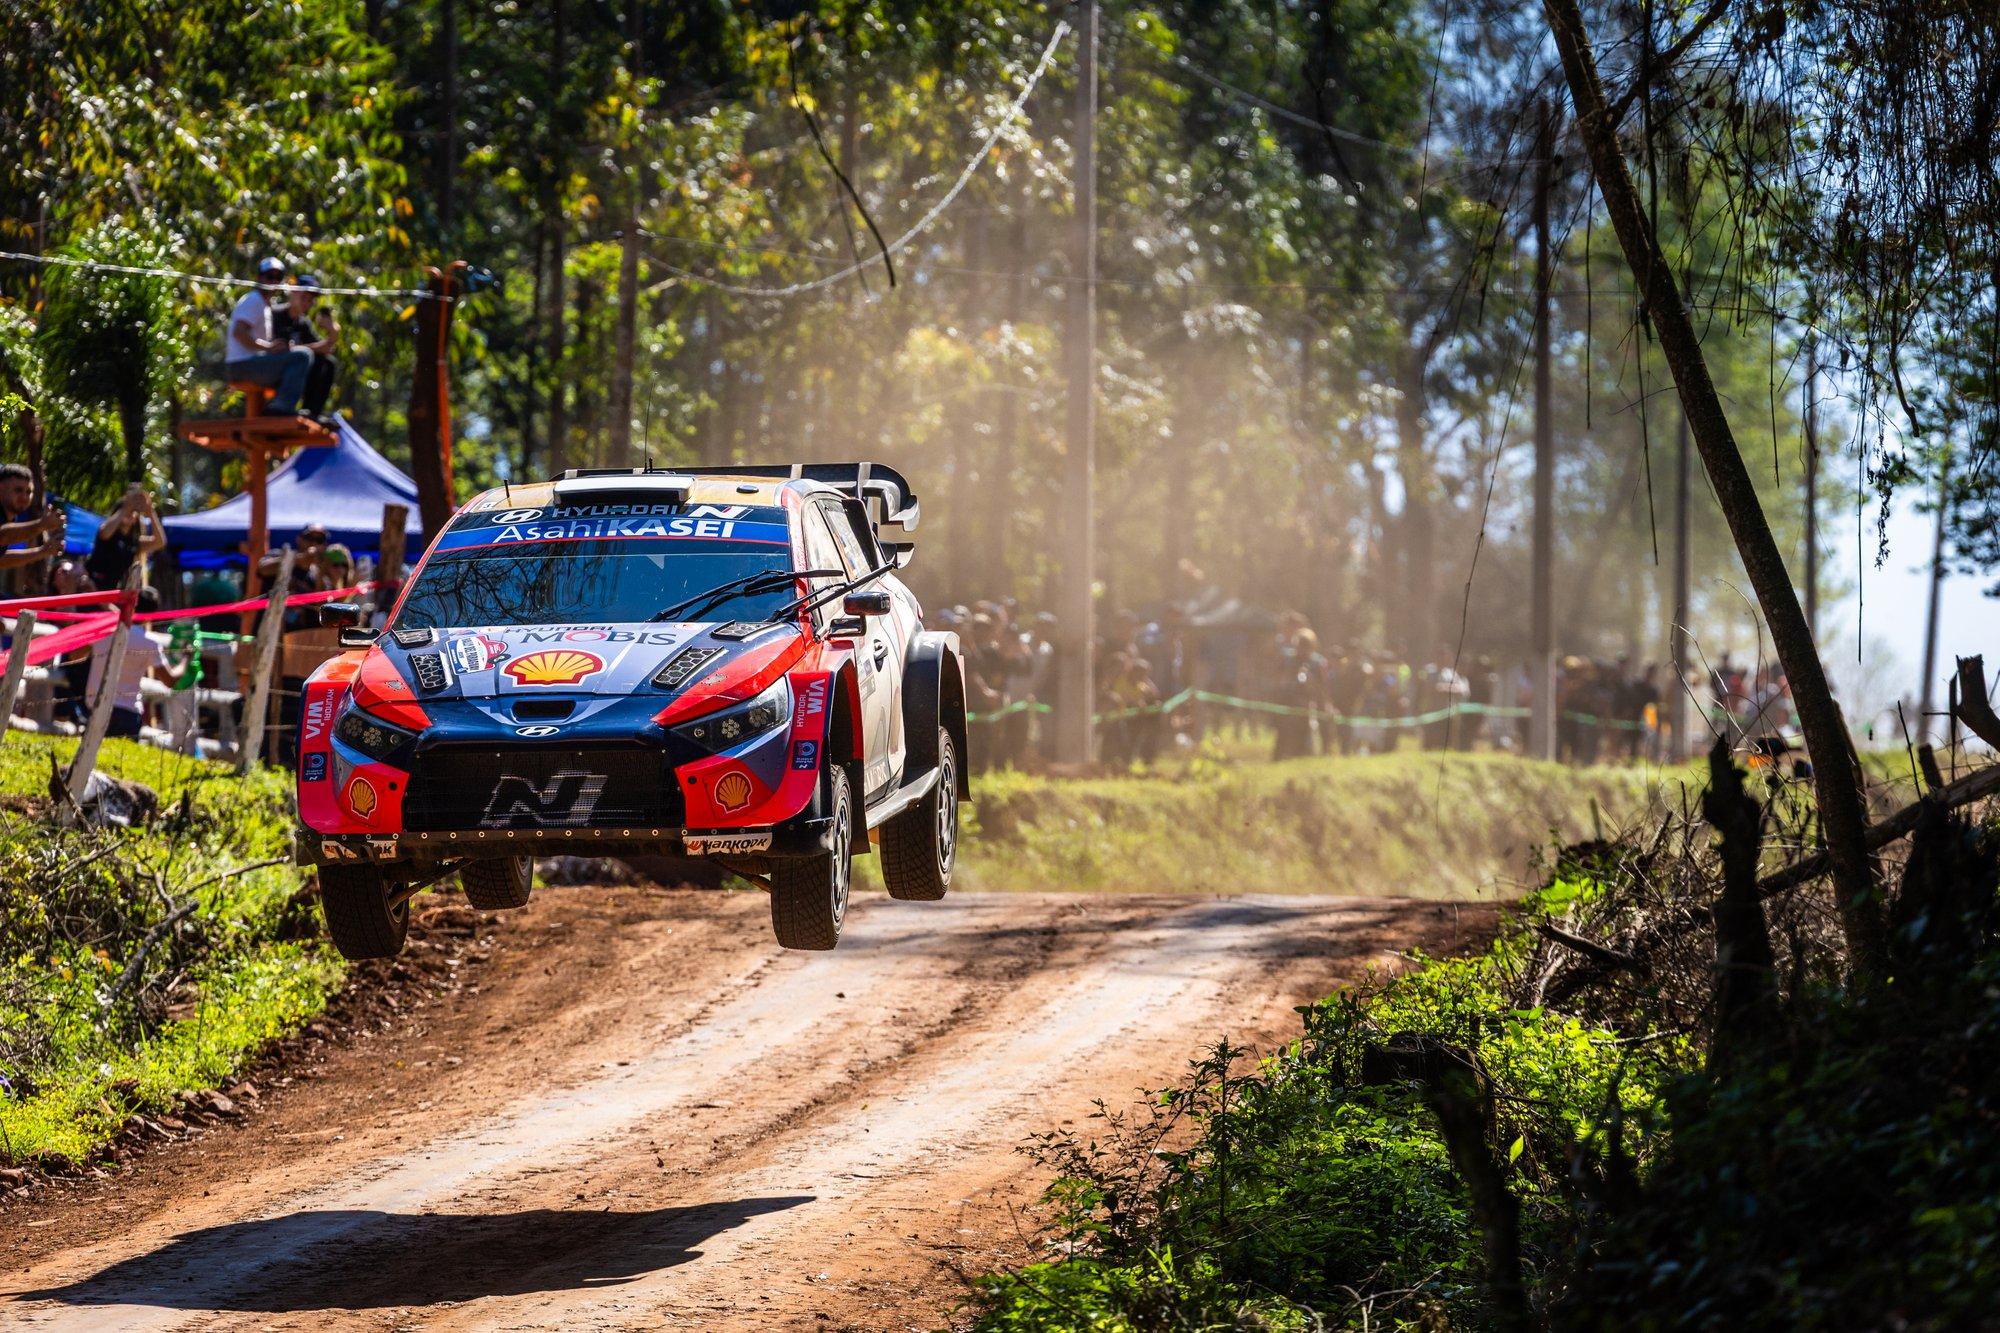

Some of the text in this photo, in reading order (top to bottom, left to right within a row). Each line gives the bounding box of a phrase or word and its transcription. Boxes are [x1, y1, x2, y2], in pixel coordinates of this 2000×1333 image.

[552, 504, 678, 518] HYUNDAI
[504, 625, 614, 634] HYUNDAI
[520, 630, 677, 645] MOBIS
[323, 688, 335, 721] HYUNDAI
[796, 694, 807, 728] HYUNDAI
[806, 678, 826, 715] WIA
[305, 700, 324, 740] WIA
